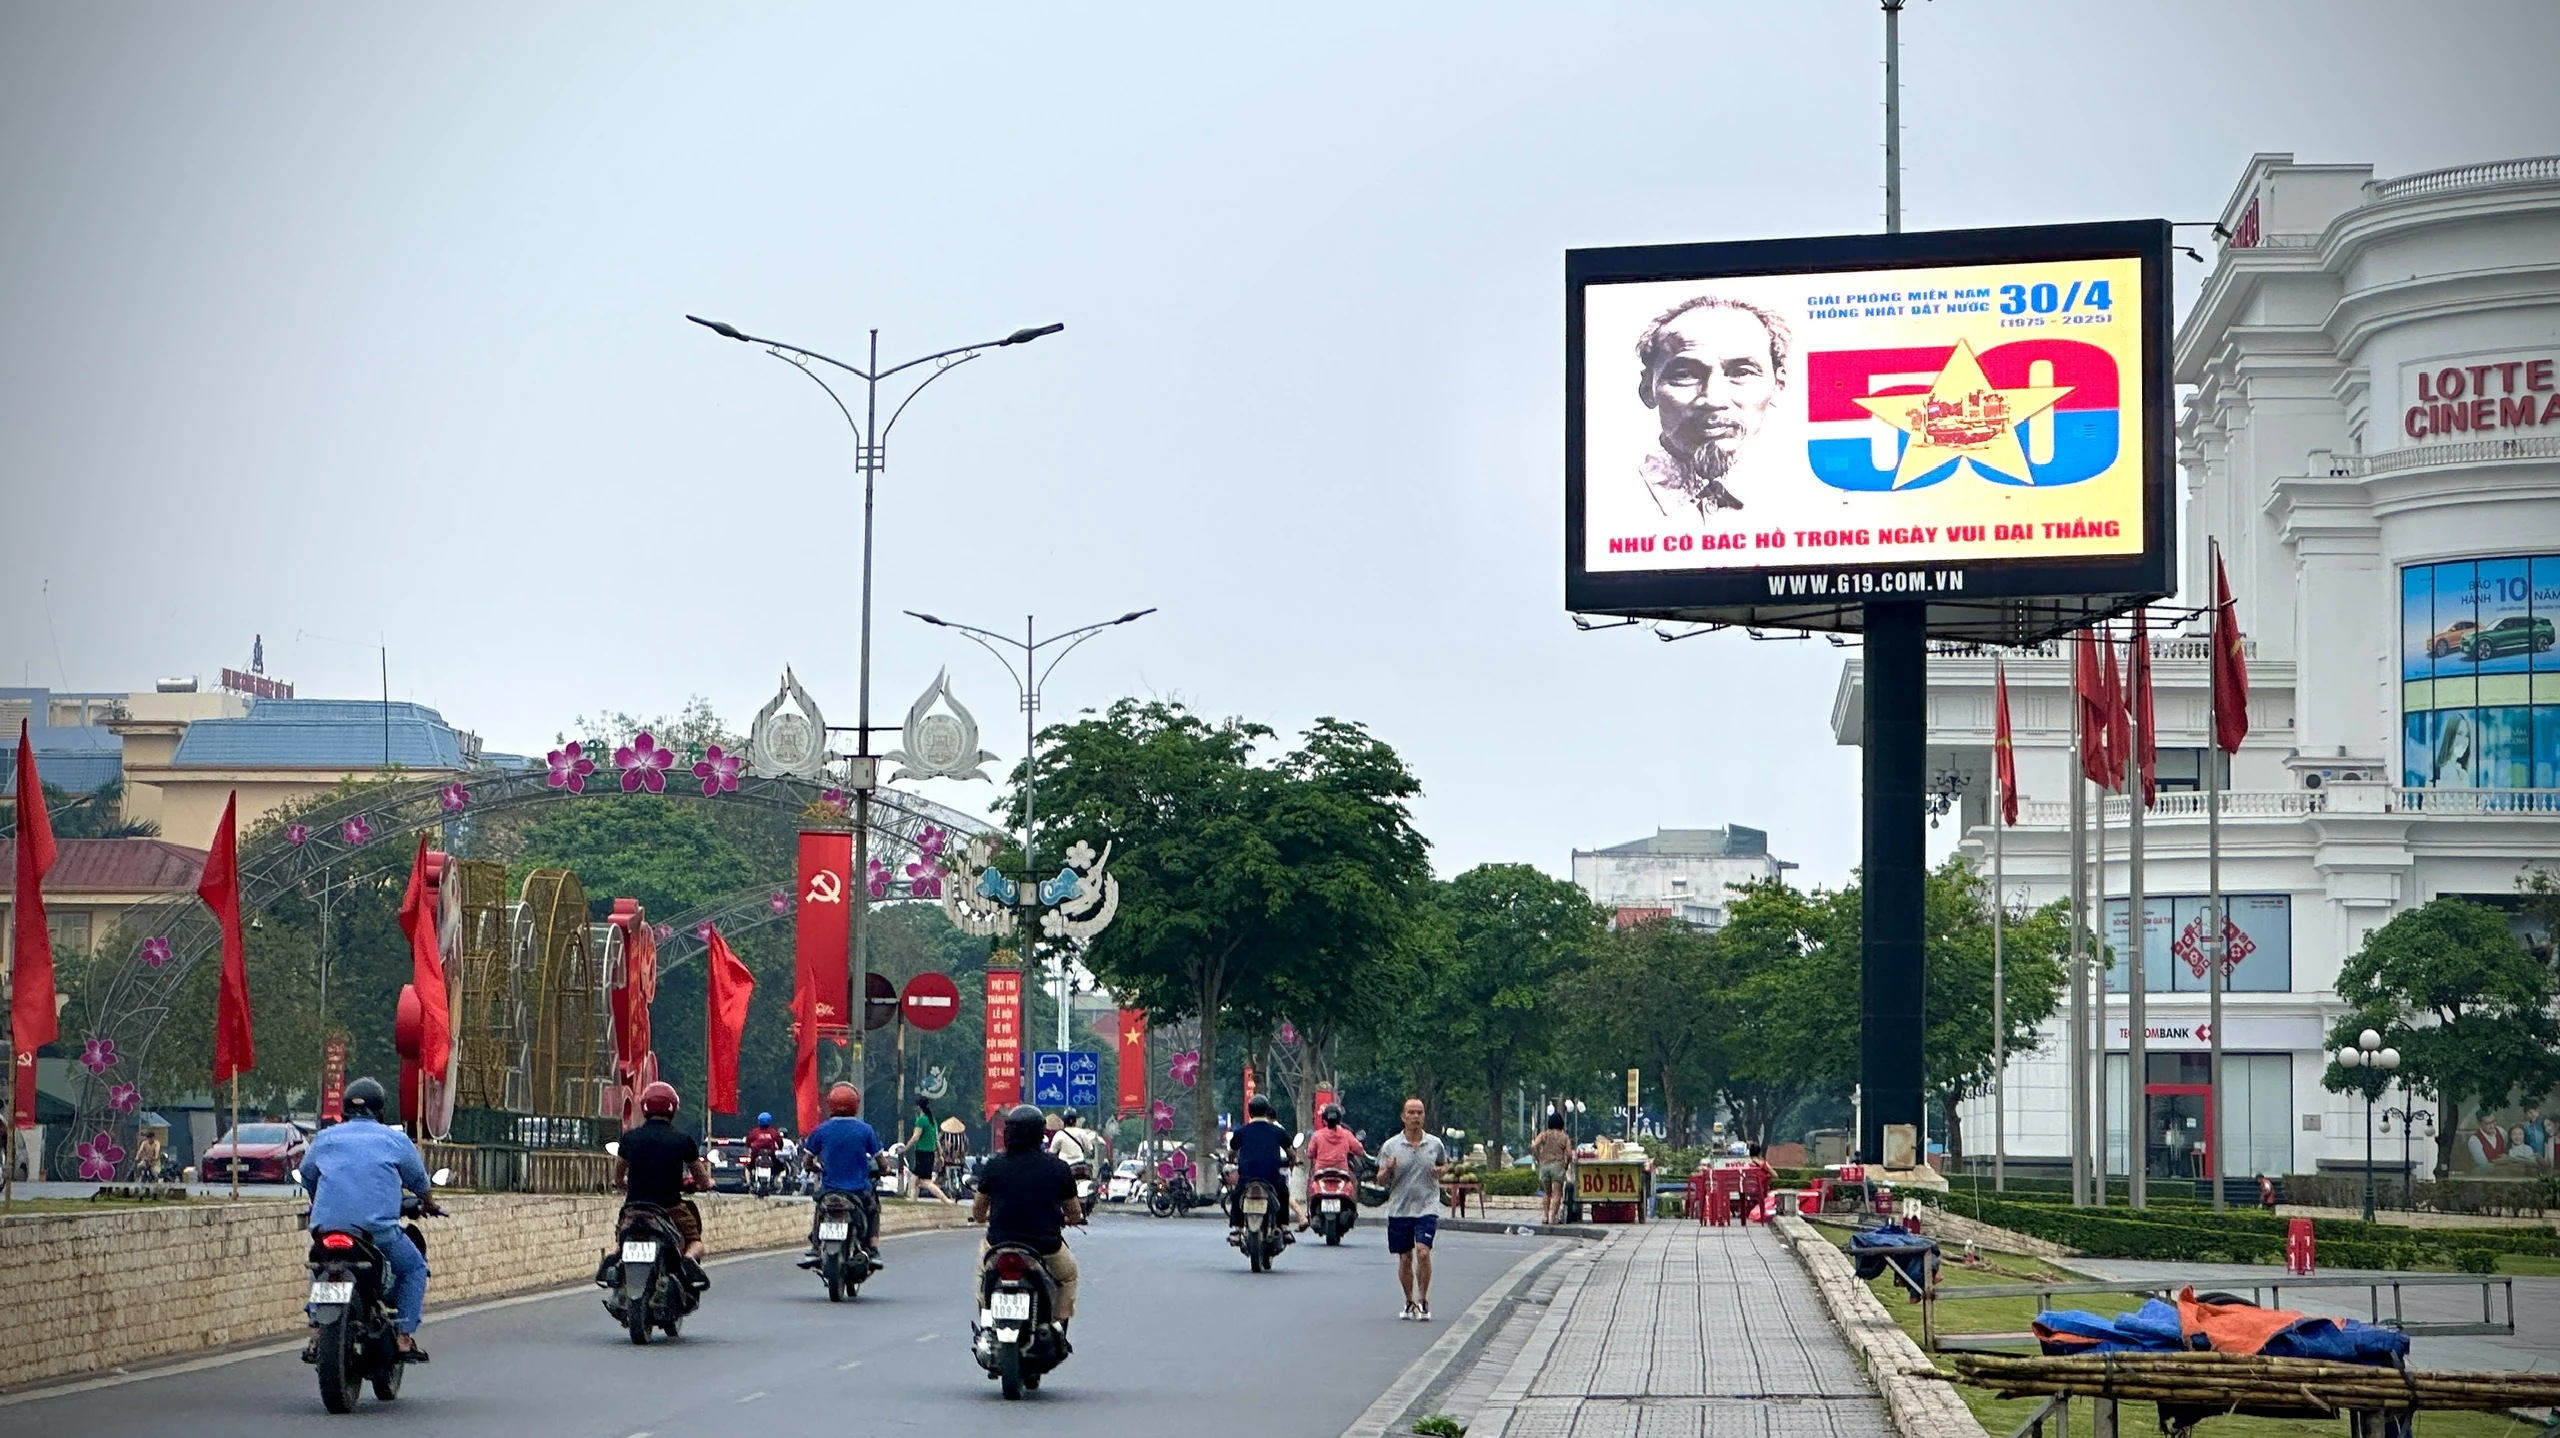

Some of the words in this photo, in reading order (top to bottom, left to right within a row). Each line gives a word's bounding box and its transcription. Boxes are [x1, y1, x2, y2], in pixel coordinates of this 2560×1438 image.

[1954, 287, 1991, 299] NAM
[1999, 280, 2113, 315] 30/4
[2418, 359, 2554, 401] LOTTE
[2404, 393, 2560, 439] CINEMA
[1609, 534, 1657, 553] NHƯ
[1702, 531, 1747, 550] BÁC
[1755, 527, 1786, 549] HỒ
[1794, 528, 1870, 548] TRONG
[1878, 525, 1938, 545] NGÀY
[1946, 525, 1986, 542] VUI
[1994, 523, 2034, 544] ĐẠI
[2042, 516, 2120, 540] THẮNG
[1768, 570, 1963, 596] WWW.G19.COM.VN
[2496, 576, 2528, 602] 10
[2461, 592, 2491, 605] HÀNH
[1001, 1067, 1015, 1078] NAM
[1583, 1168, 1604, 1193] BÒ
[1608, 1167, 1636, 1193] BÍA
